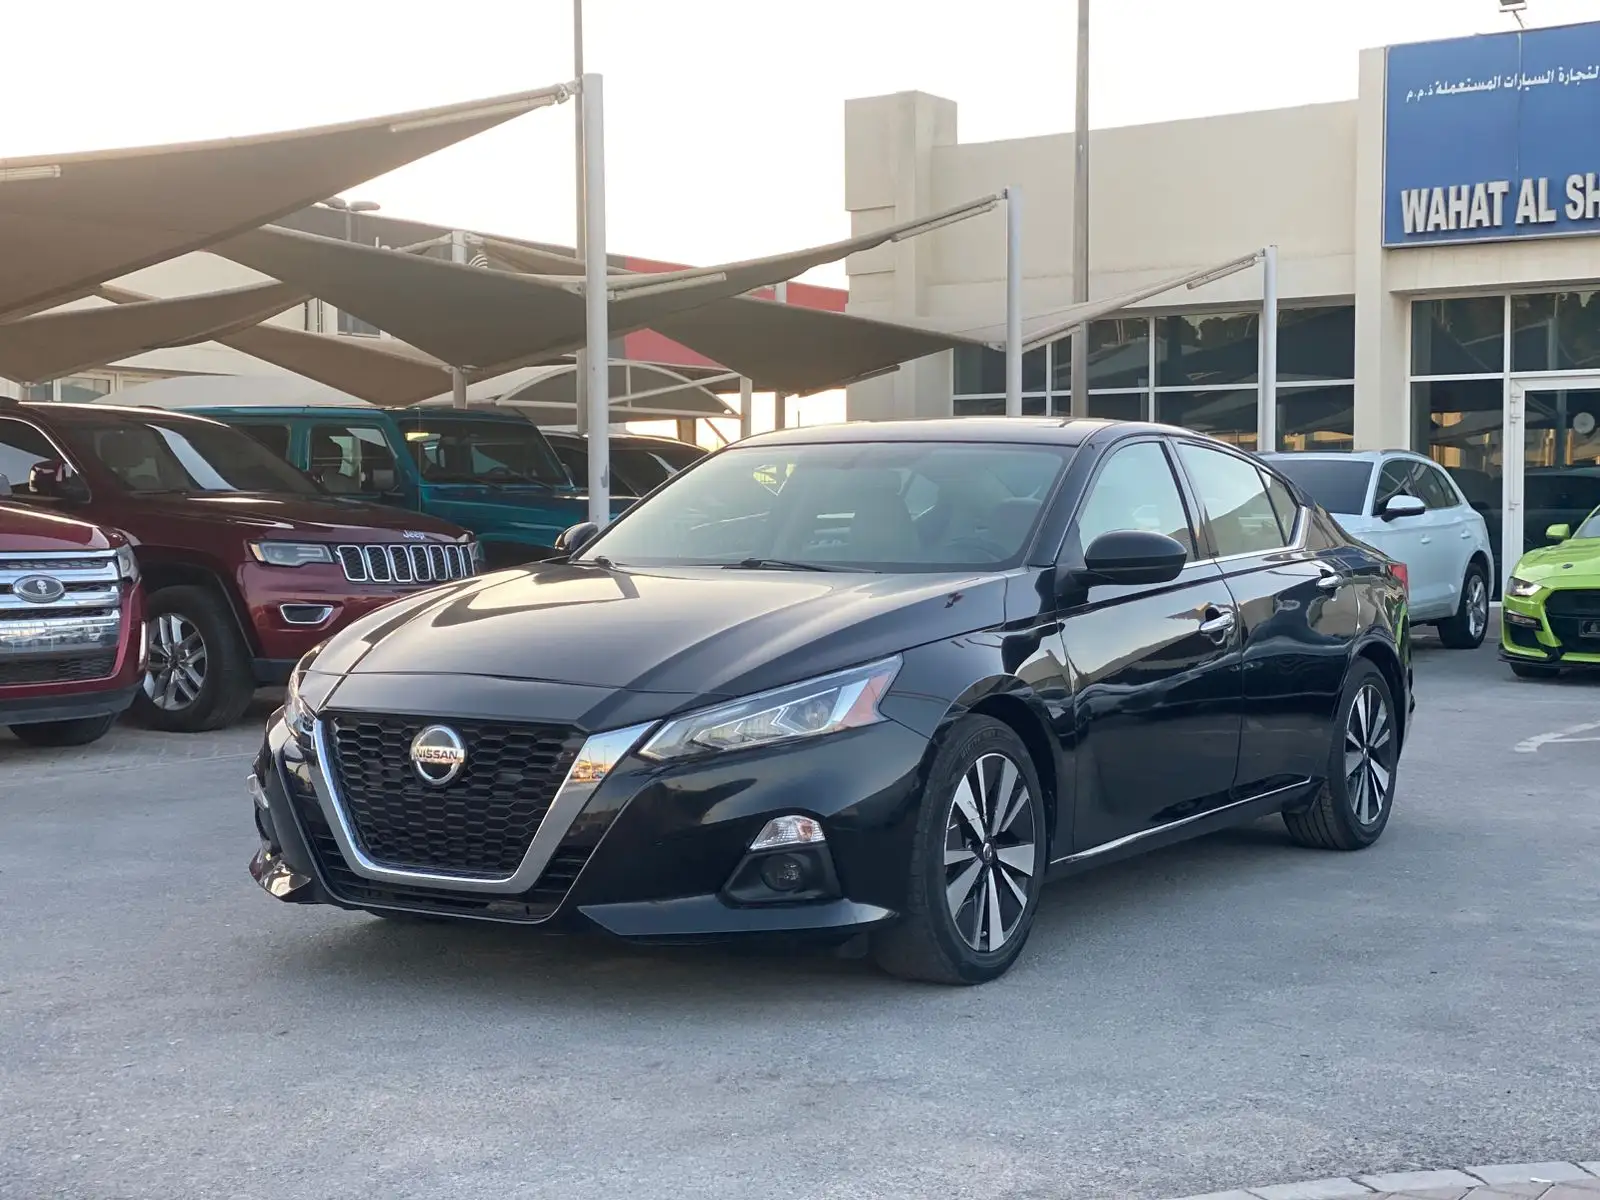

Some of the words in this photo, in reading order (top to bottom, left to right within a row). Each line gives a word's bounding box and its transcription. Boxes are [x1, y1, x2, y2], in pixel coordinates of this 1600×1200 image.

[1435, 75, 1502, 95] المستعملة
[1503, 69, 1555, 91] السيارات
[1401, 180, 1509, 234] WAHAT
[1515, 177, 1557, 225] AL
[402, 529, 425, 540] Jeep
[415, 747, 458, 760] NISSAN
